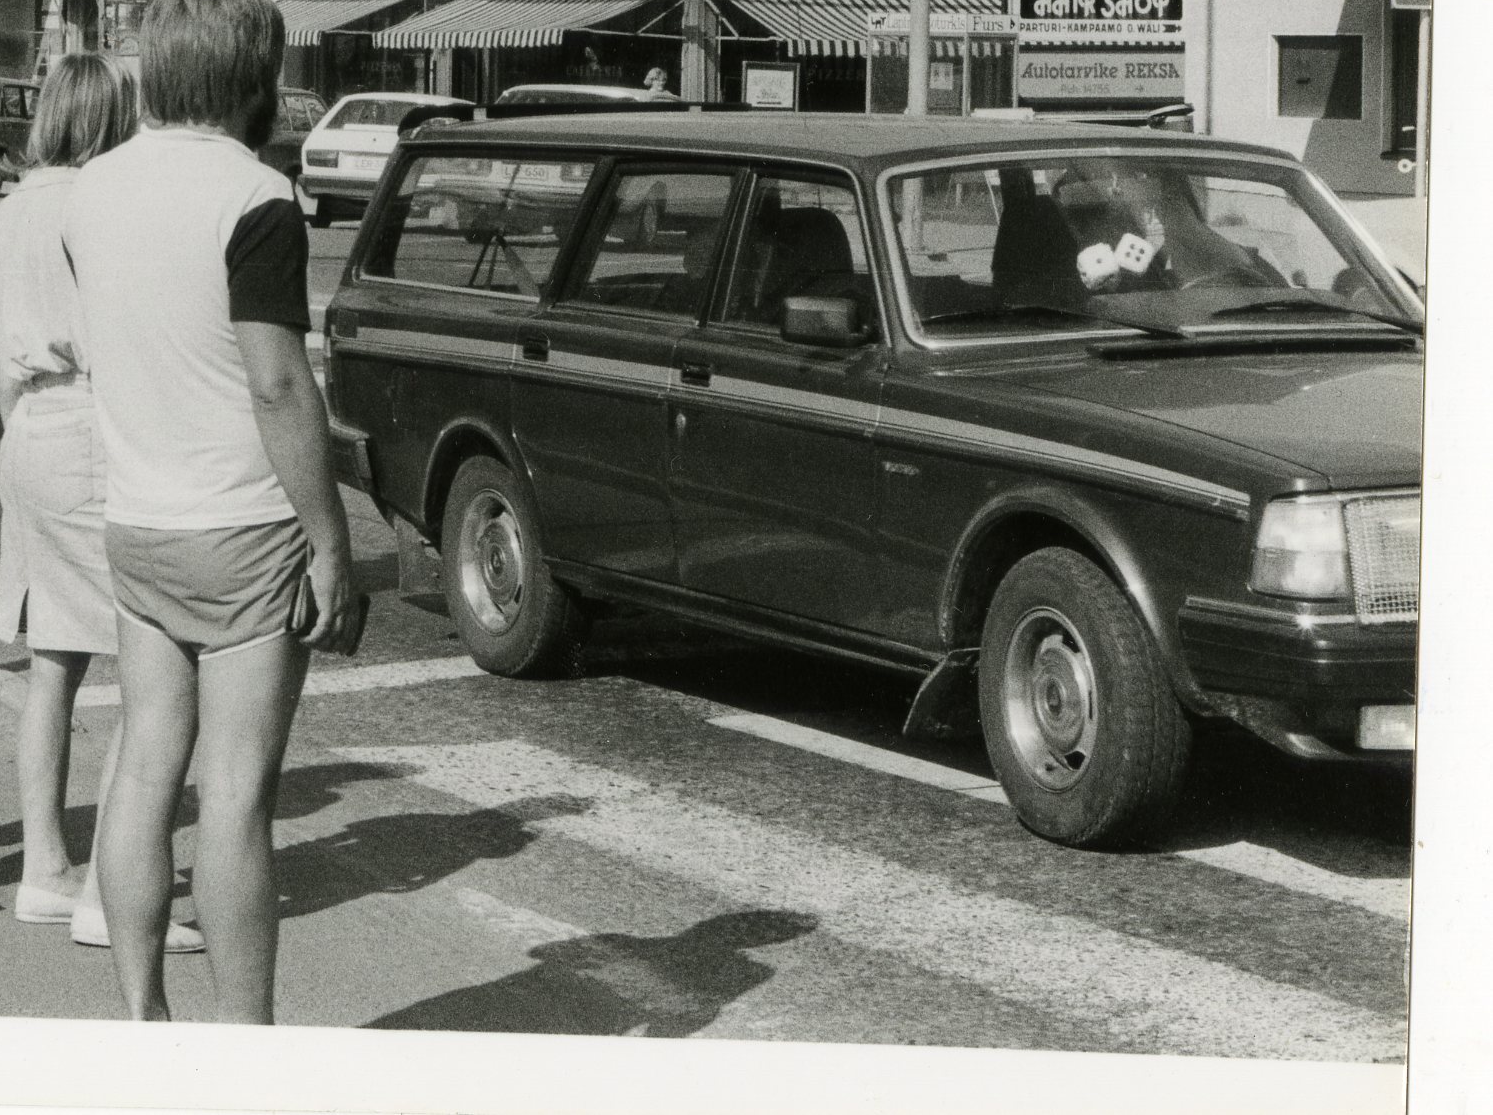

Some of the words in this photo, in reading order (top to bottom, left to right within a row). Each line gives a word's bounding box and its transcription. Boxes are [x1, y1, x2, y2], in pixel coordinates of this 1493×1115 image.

[973, 16, 1004, 31] Furs
[1137, 23, 1160, 33] WALI
[1021, 63, 1118, 79] Autotarvike
[1125, 63, 1180, 79] REKSA
